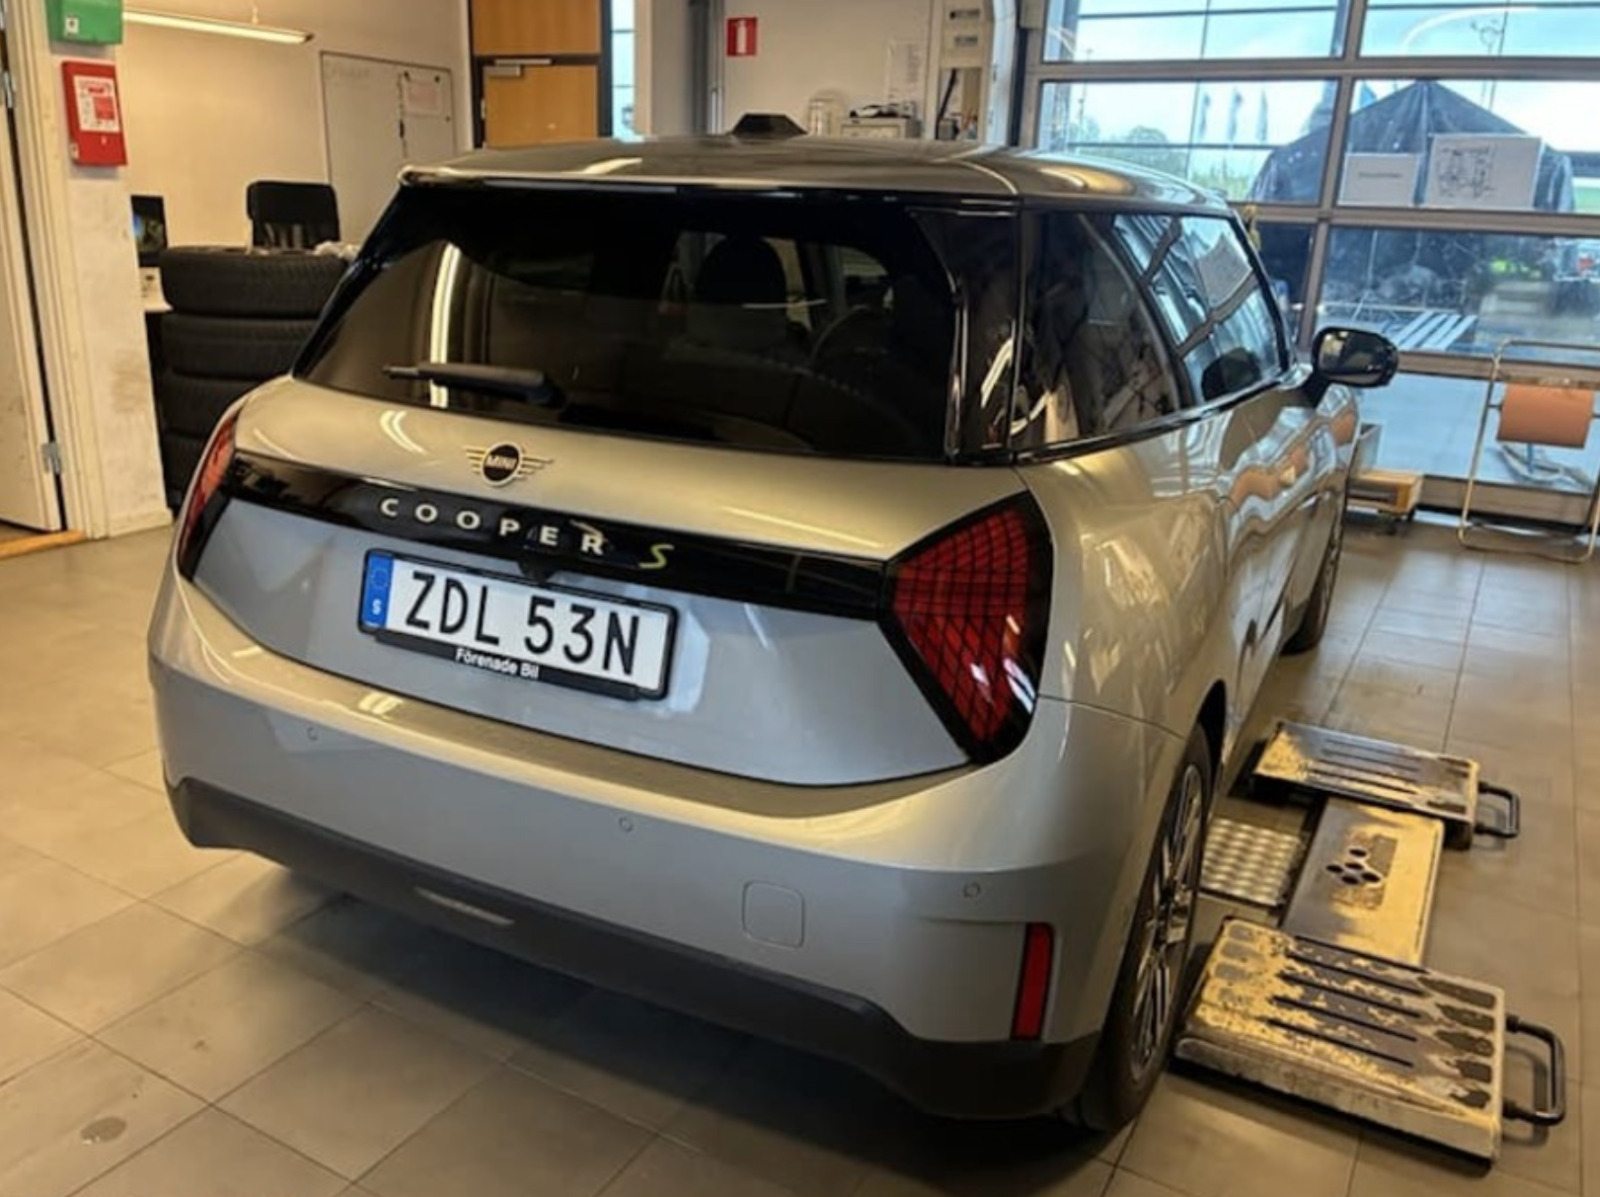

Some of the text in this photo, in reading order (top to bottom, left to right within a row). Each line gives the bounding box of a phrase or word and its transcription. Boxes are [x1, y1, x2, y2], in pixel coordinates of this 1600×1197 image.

[380, 498, 675, 569] COOPER S
[405, 570, 640, 675] ZDL 53N
